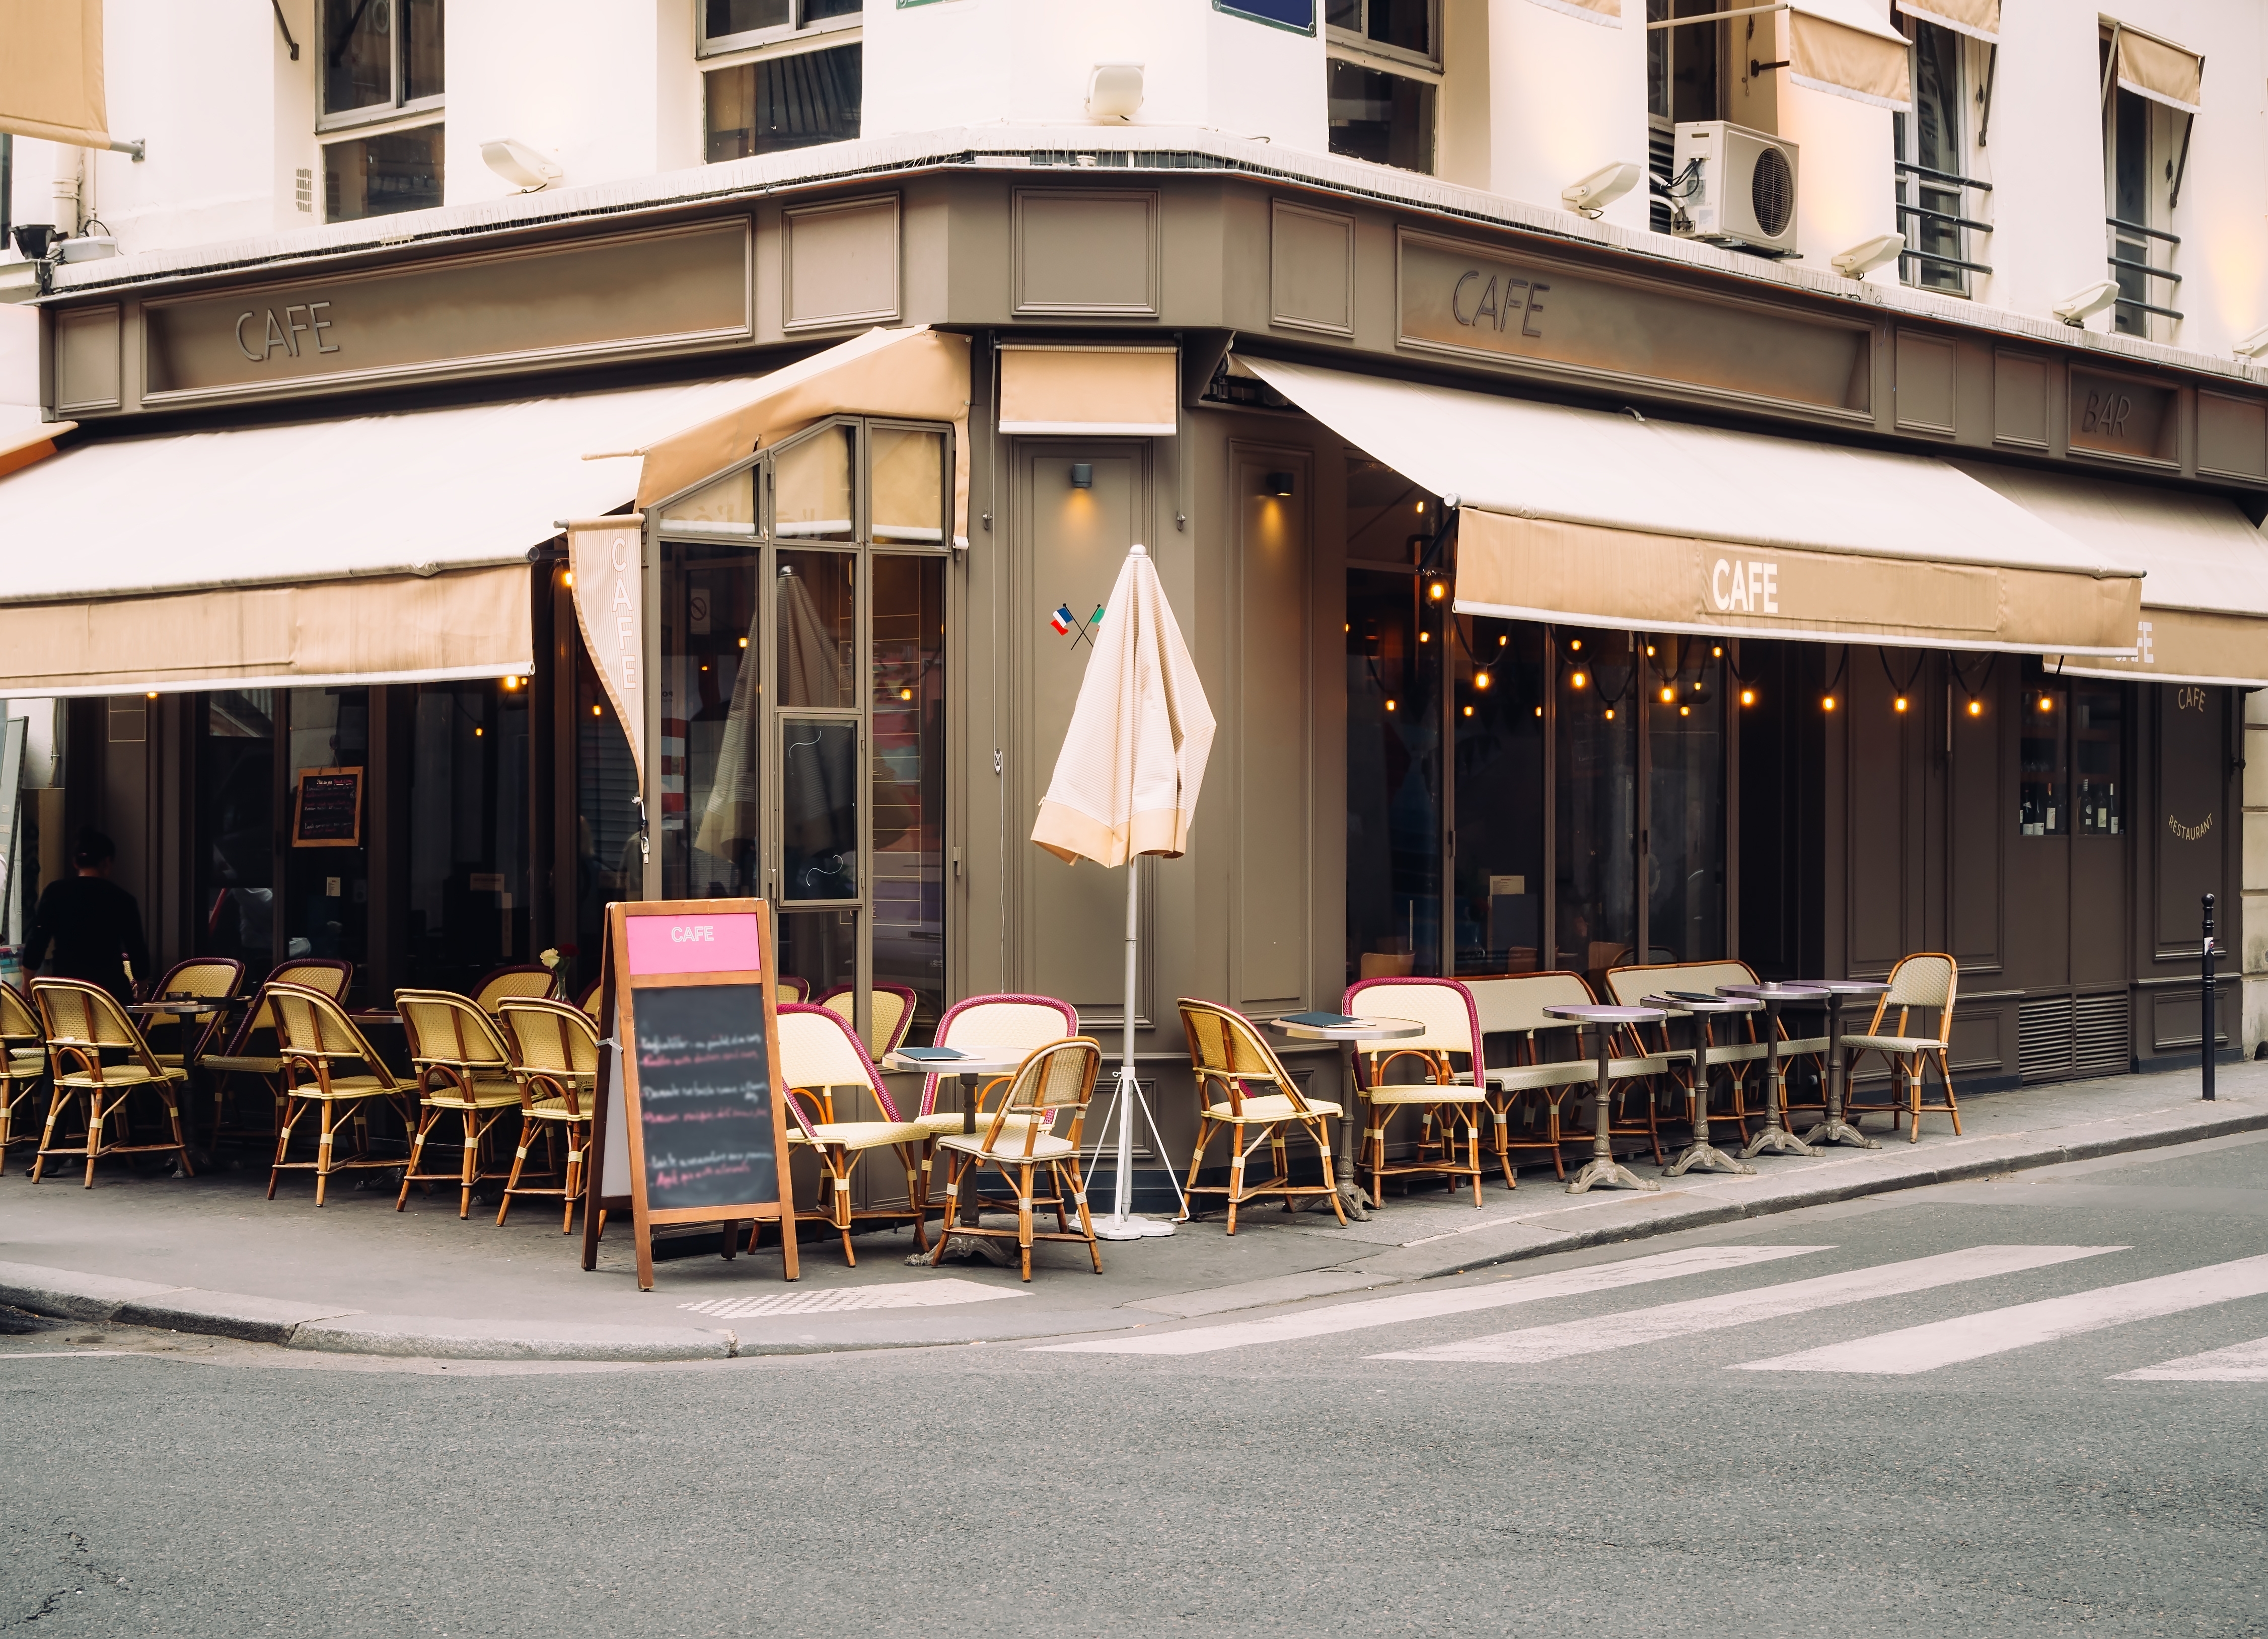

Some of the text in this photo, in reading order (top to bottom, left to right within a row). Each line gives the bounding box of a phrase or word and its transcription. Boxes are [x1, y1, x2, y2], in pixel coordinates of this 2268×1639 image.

[1452, 270, 1550, 338] CAFE
[235, 301, 340, 362] CAFE
[2082, 390, 2131, 436] BAR
[1712, 558, 1779, 613] CAFE
[611, 537, 636, 690] CAFE
[2178, 687, 2206, 712] CAFE
[2168, 813, 2213, 841] RESTAURANT
[671, 926, 714, 943] CAFE
